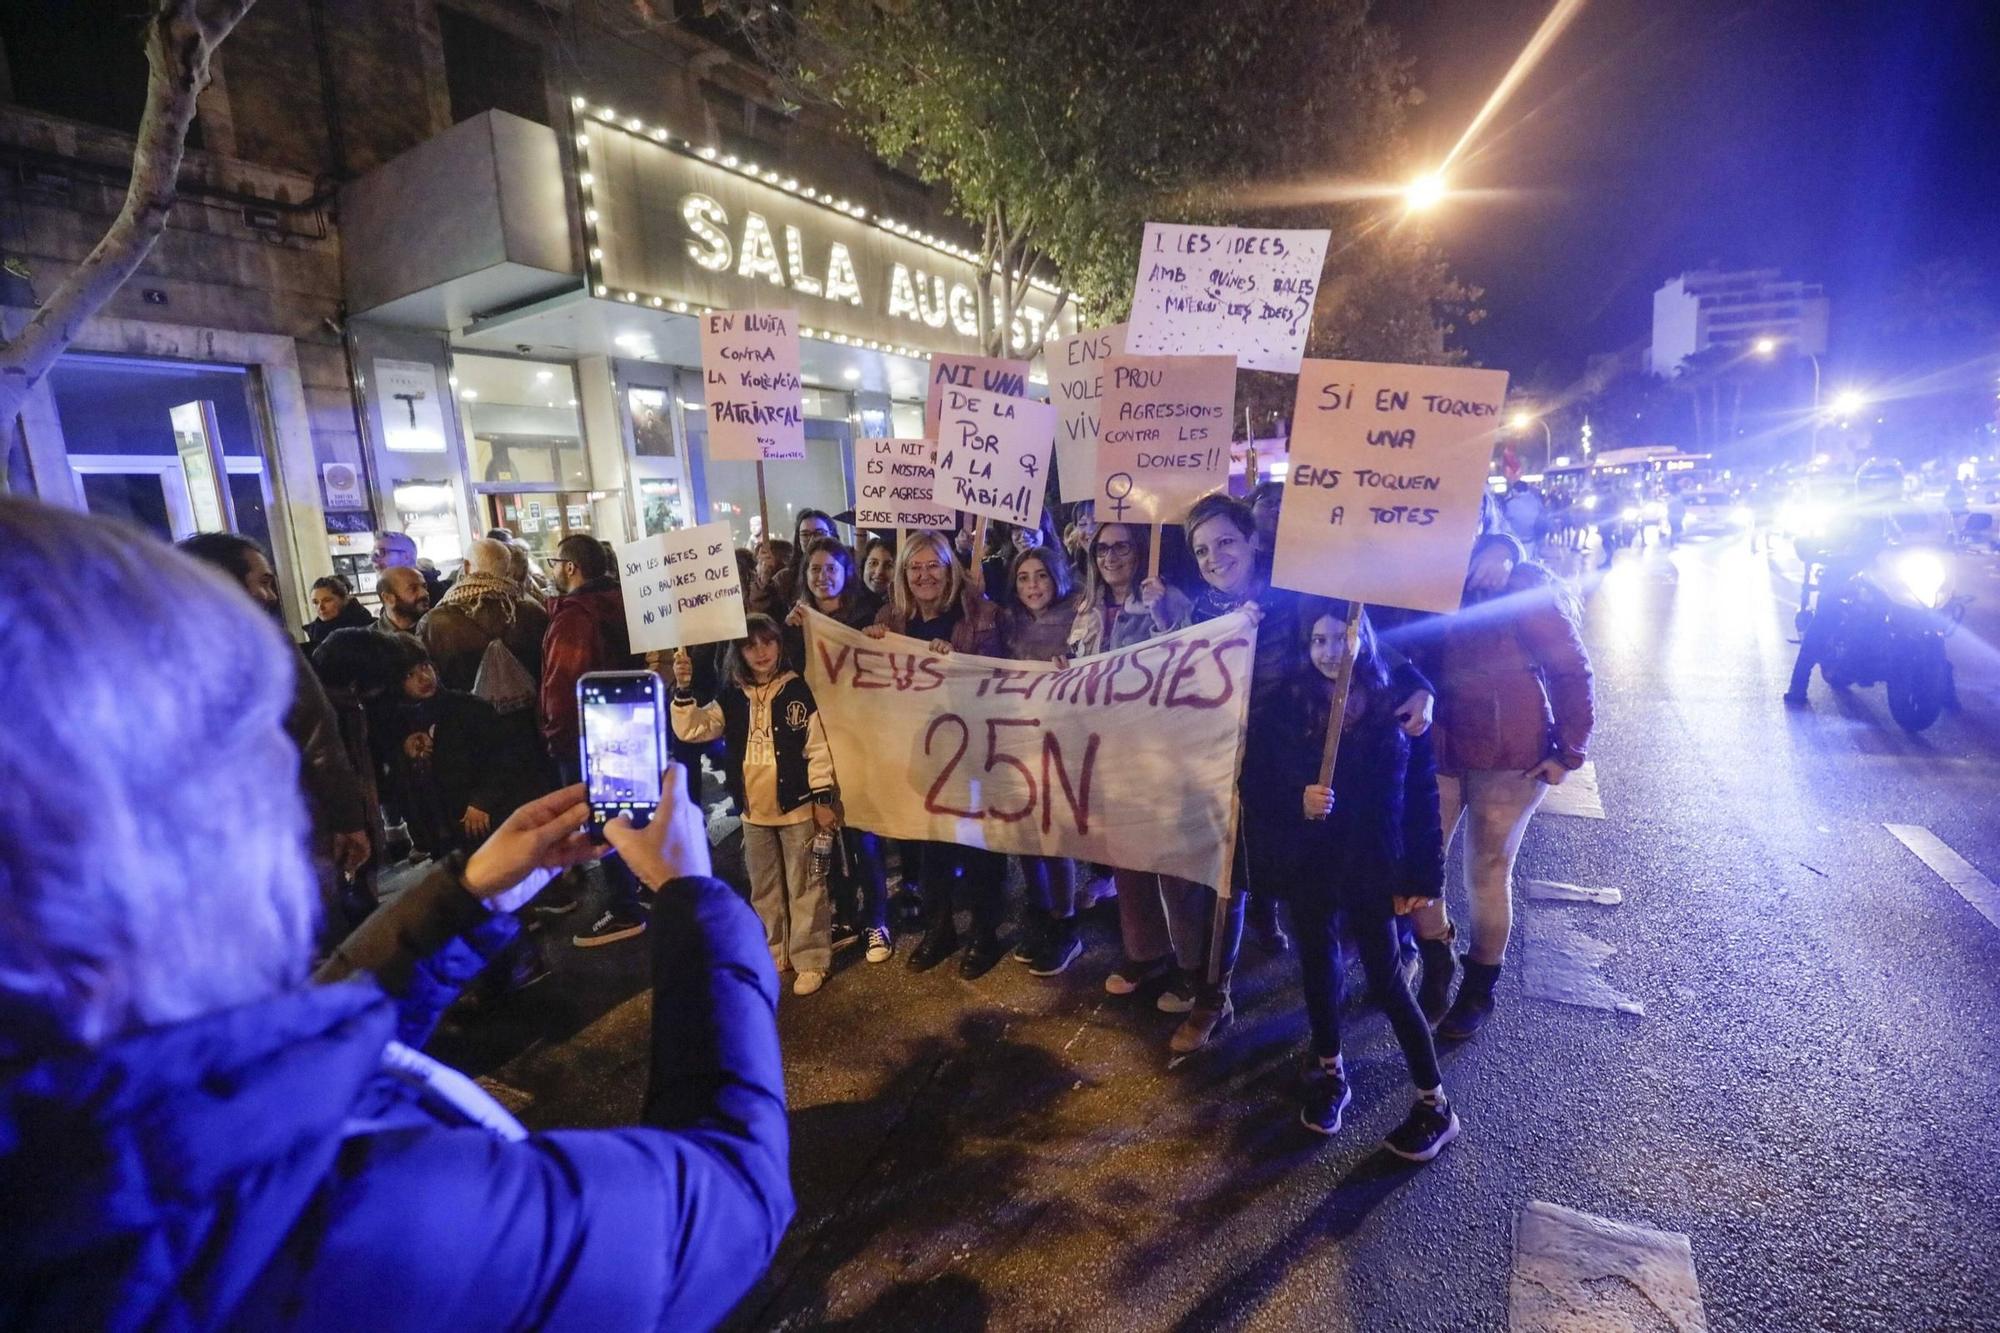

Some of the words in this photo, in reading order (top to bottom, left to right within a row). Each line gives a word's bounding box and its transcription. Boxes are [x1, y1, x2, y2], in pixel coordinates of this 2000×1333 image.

[683, 192, 864, 308] SALA
[1177, 233, 1211, 254] LES
[1148, 264, 1186, 283] AMB
[710, 314, 735, 334] EN
[720, 346, 775, 362] CONTRA
[1068, 335, 1112, 366] ENS
[708, 370, 727, 385] LA
[935, 362, 976, 388] NI
[983, 369, 1025, 397] UNA
[1061, 376, 1104, 401] VOLE
[1114, 366, 1164, 389] PROU
[949, 391, 981, 413] DE
[993, 402, 1015, 419] LA
[1376, 388, 1409, 412] EN
[1423, 395, 1499, 417] TOQUEN
[954, 419, 1000, 455] POR
[1105, 428, 1160, 444] CONTRA
[1178, 425, 1209, 441] LES
[1367, 428, 1416, 449] UNA
[875, 441, 891, 454] LA
[901, 442, 925, 456] NIT
[1137, 447, 1221, 471] DONES!!
[891, 463, 935, 479] NOSTRA
[940, 450, 954, 469] A
[969, 459, 992, 480] LA
[1293, 464, 1342, 489] ENS
[1353, 469, 1440, 491] TOQUEN
[862, 485, 886, 499] CAP
[889, 486, 934, 501] AGRESS
[857, 509, 893, 524] SENSE
[897, 511, 952, 525] RESPOSTA
[1330, 506, 1345, 526] A
[1369, 506, 1440, 526] TOTES
[663, 548, 698, 566] NETES
[708, 543, 723, 556] DE
[705, 565, 730, 581] QUE
[643, 609, 655, 625] NO
[817, 639, 946, 692] VEUS
[923, 713, 1101, 836] 25N
